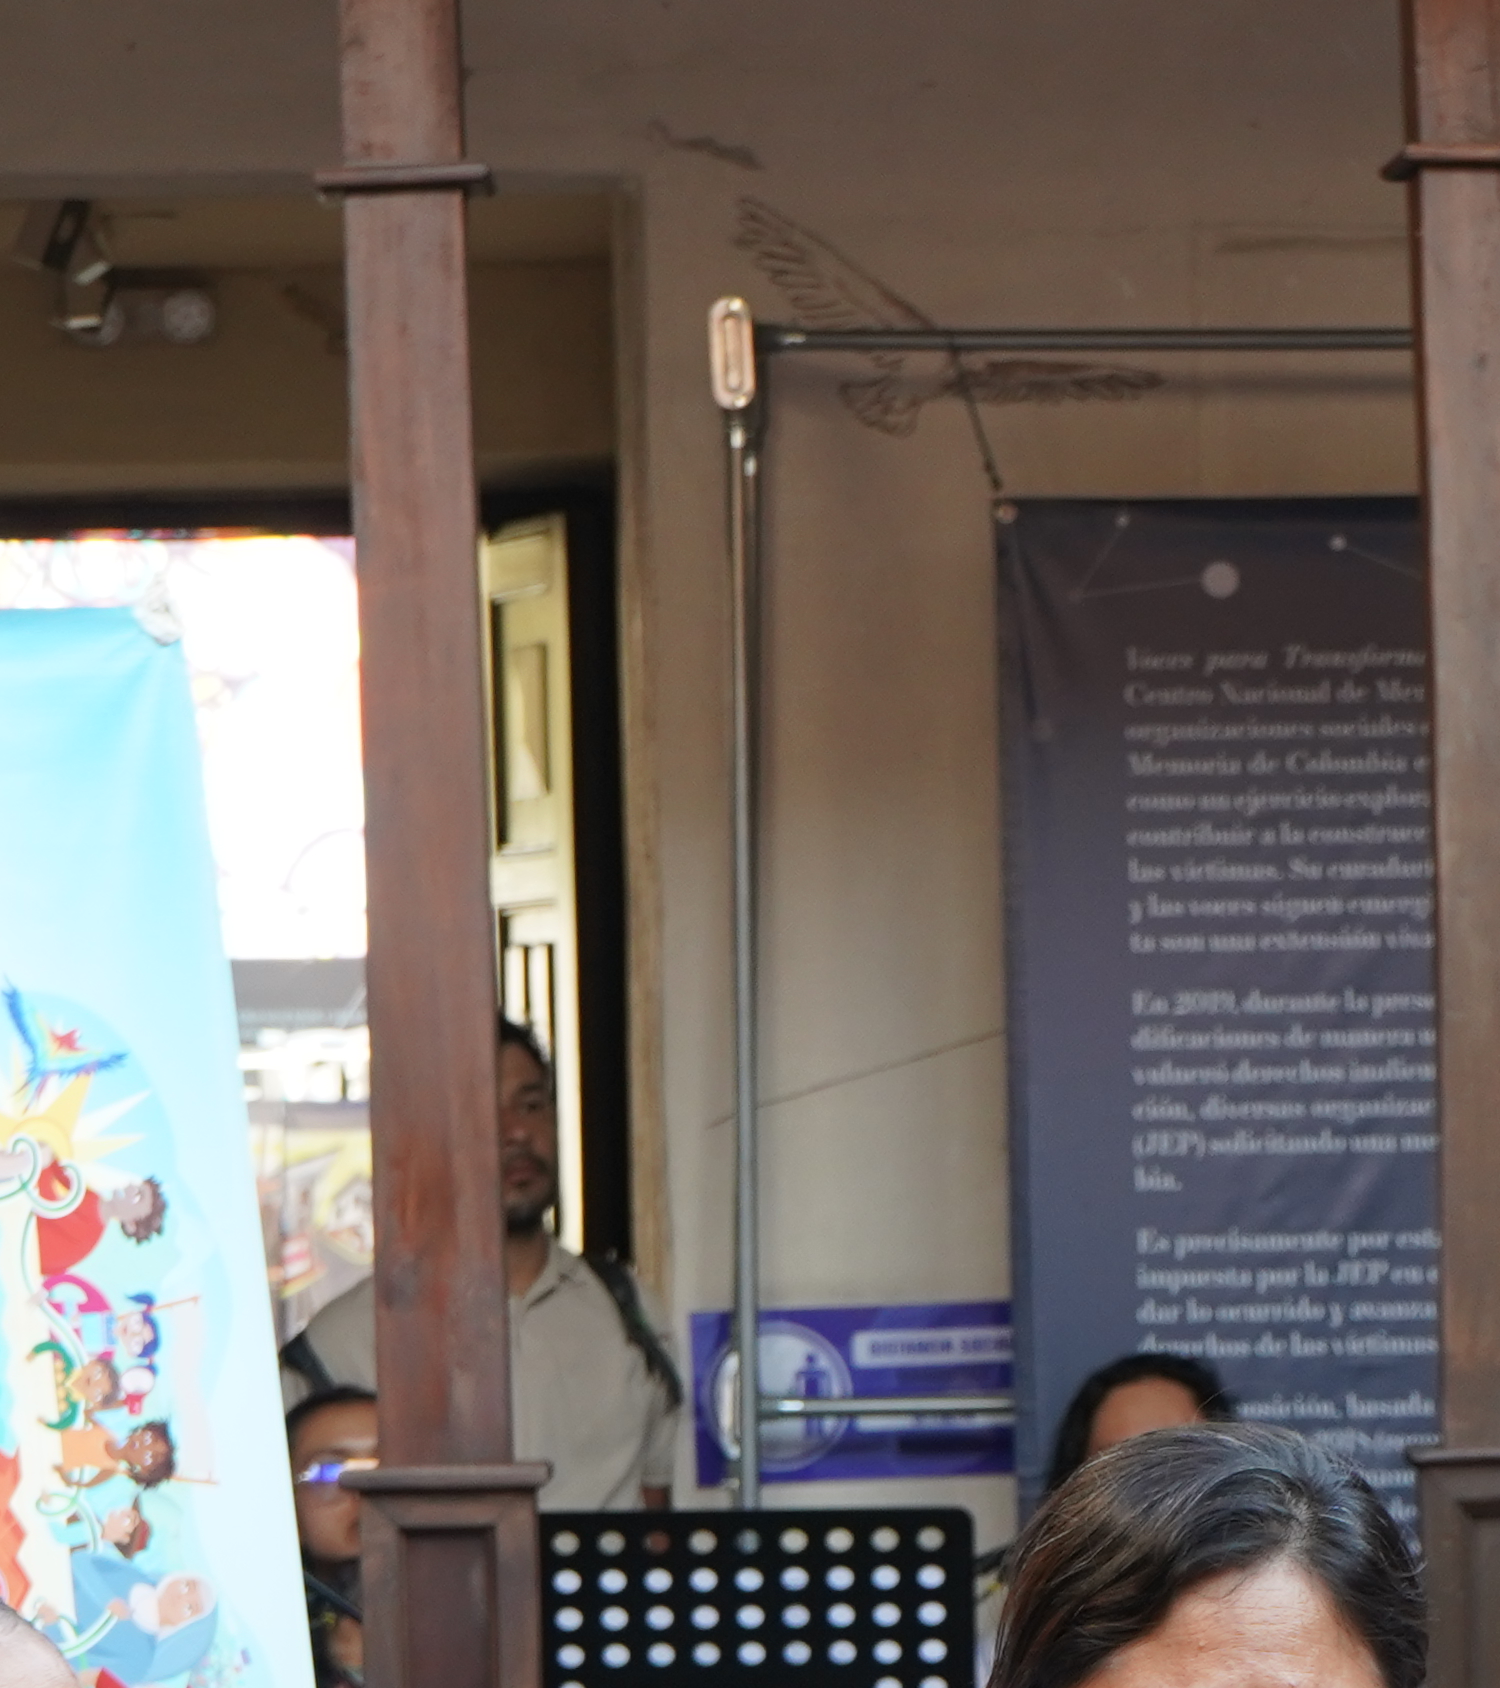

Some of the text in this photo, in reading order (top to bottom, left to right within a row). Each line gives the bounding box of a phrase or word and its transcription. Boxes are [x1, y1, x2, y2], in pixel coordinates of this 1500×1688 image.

[1246, 751, 1280, 776] de
[1284, 750, 1408, 775] Colombia
[1128, 900, 1143, 925] y
[1131, 990, 1170, 1016] En
[1283, 1023, 1317, 1049] de
[1347, 1231, 1393, 1257] por
[1255, 1267, 1299, 1295] por
[1329, 1302, 1344, 1328] y
